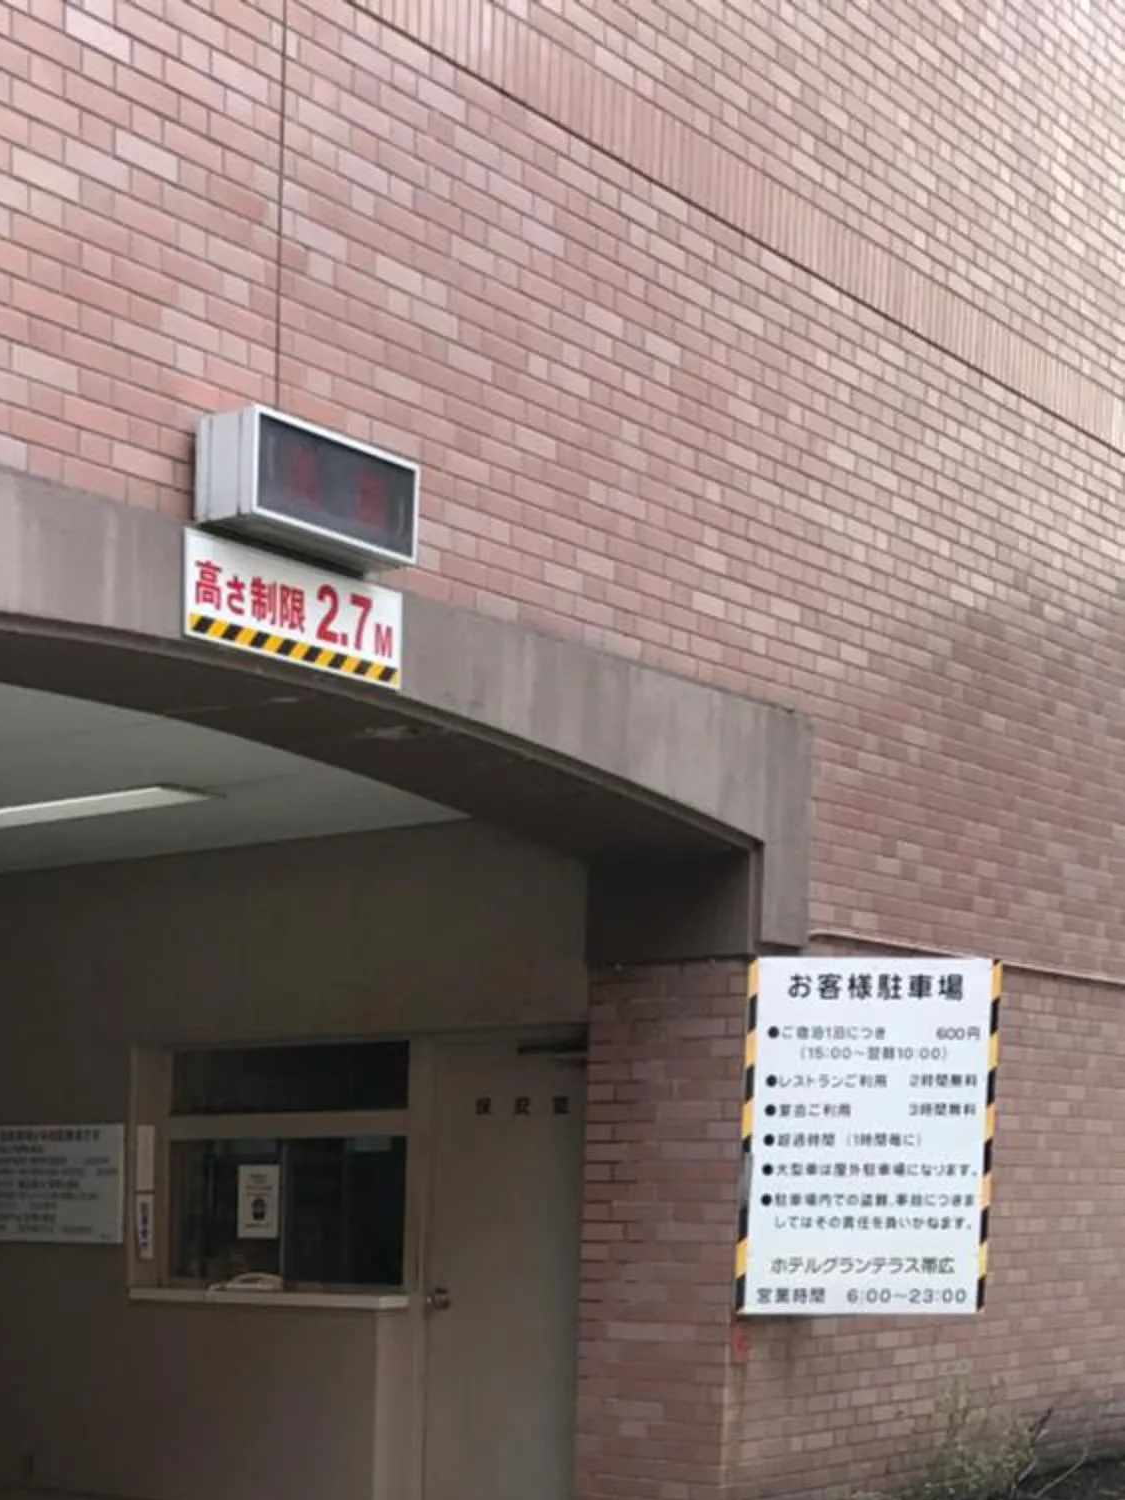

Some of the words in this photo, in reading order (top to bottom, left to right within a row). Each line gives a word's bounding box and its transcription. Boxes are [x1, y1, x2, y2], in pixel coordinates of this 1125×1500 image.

[195, 560, 305, 633] 高さ制限
[788, 974, 964, 1001] お客様駐車場
[936, 1026, 980, 1041] 600円
[778, 1074, 888, 1089] レストランご利用
[909, 1074, 978, 1088] 2時間無料
[779, 1104, 852, 1118] 宴会ご利用
[909, 1104, 977, 1117] 3時間無料
[777, 1133, 836, 1147] 超過時間
[771, 1257, 955, 1275] ホテルグランテラス帯広
[756, 1288, 826, 1304] 営業時間
